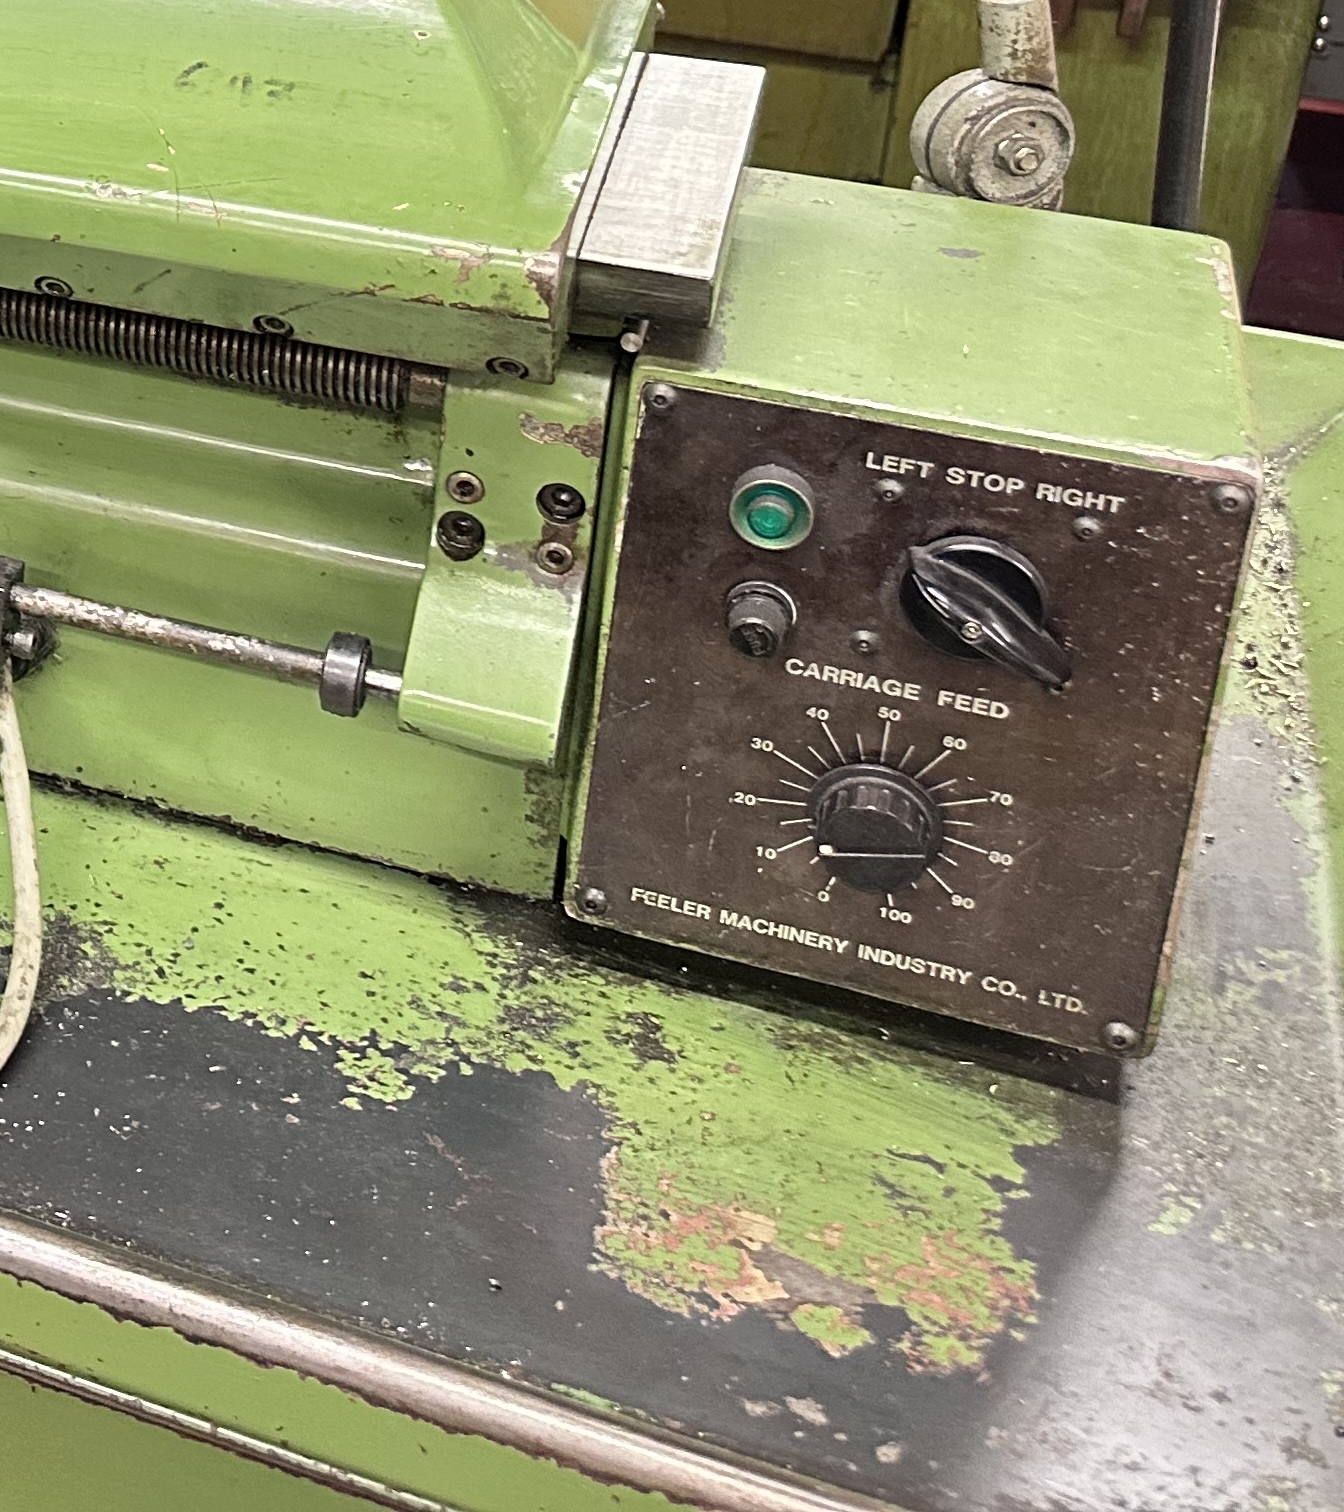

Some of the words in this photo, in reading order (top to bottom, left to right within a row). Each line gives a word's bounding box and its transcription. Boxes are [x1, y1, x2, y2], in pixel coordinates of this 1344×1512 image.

[865, 451, 935, 479] LEFT
[945, 466, 1026, 496] STOP
[1035, 482, 1126, 514] RIGHT
[784, 657, 923, 702] CARRIAGE
[936, 689, 1011, 721] FEED
[805, 706, 831, 722] 40
[876, 705, 902, 722] 50
[750, 737, 774, 752] 30
[941, 735, 968, 751] 60
[732, 791, 757, 808] 20
[988, 790, 1014, 807] 70
[755, 845, 778, 861] 10
[816, 889, 831, 904] 0
[950, 893, 976, 910] 90
[878, 906, 913, 925] 100
[630, 886, 712, 921] FEELER
[718, 908, 850, 955] MACHINERY
[857, 942, 973, 986] INDUSTRY
[1037, 988, 1089, 1016] LTD.
